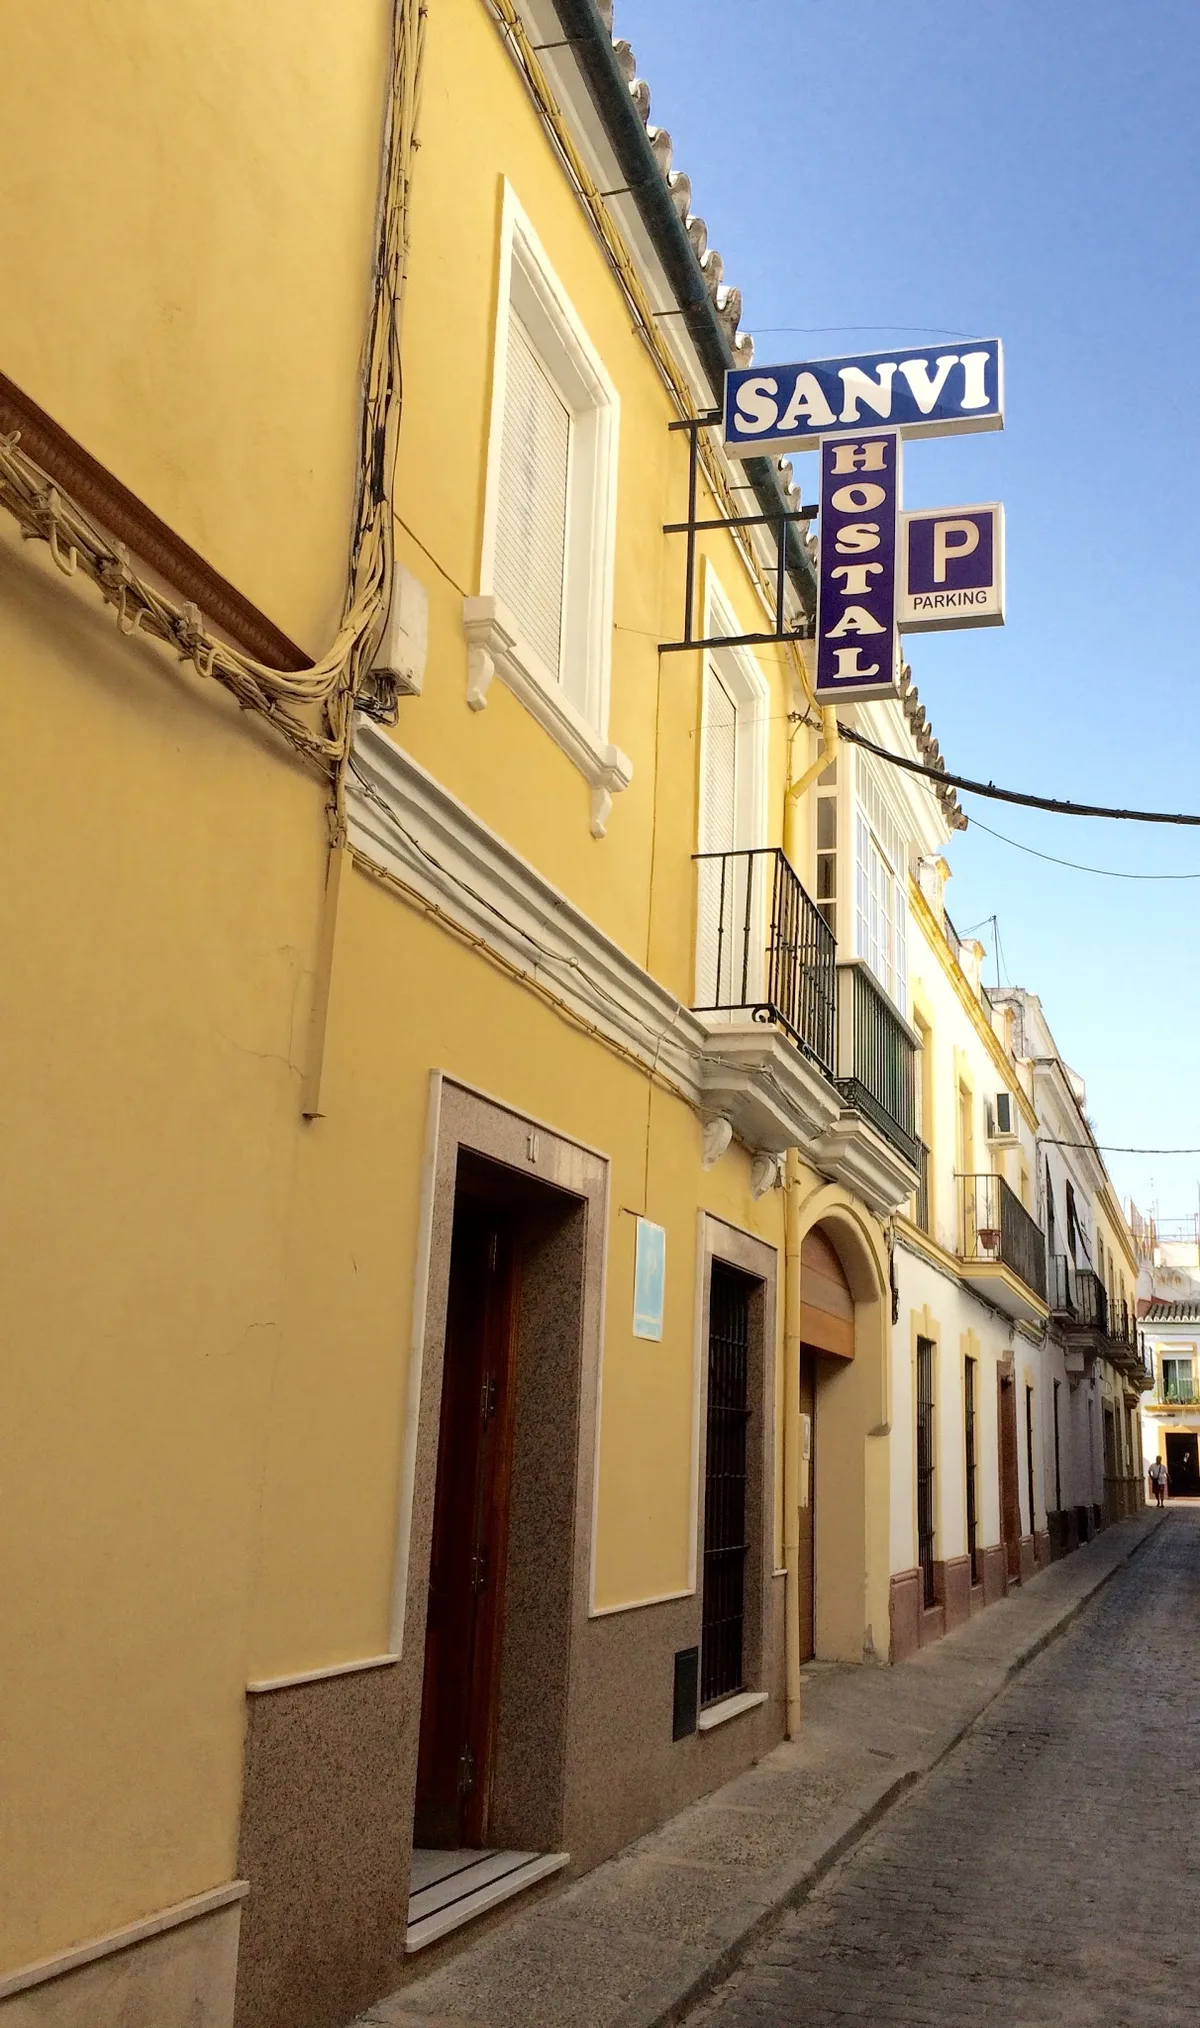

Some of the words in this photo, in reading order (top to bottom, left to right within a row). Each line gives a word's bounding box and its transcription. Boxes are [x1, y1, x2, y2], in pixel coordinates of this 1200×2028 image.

[733, 351, 991, 434] SANVI
[824, 441, 889, 680] HOSTAL
[932, 518, 981, 583] P
[913, 589, 988, 611] PARKING
